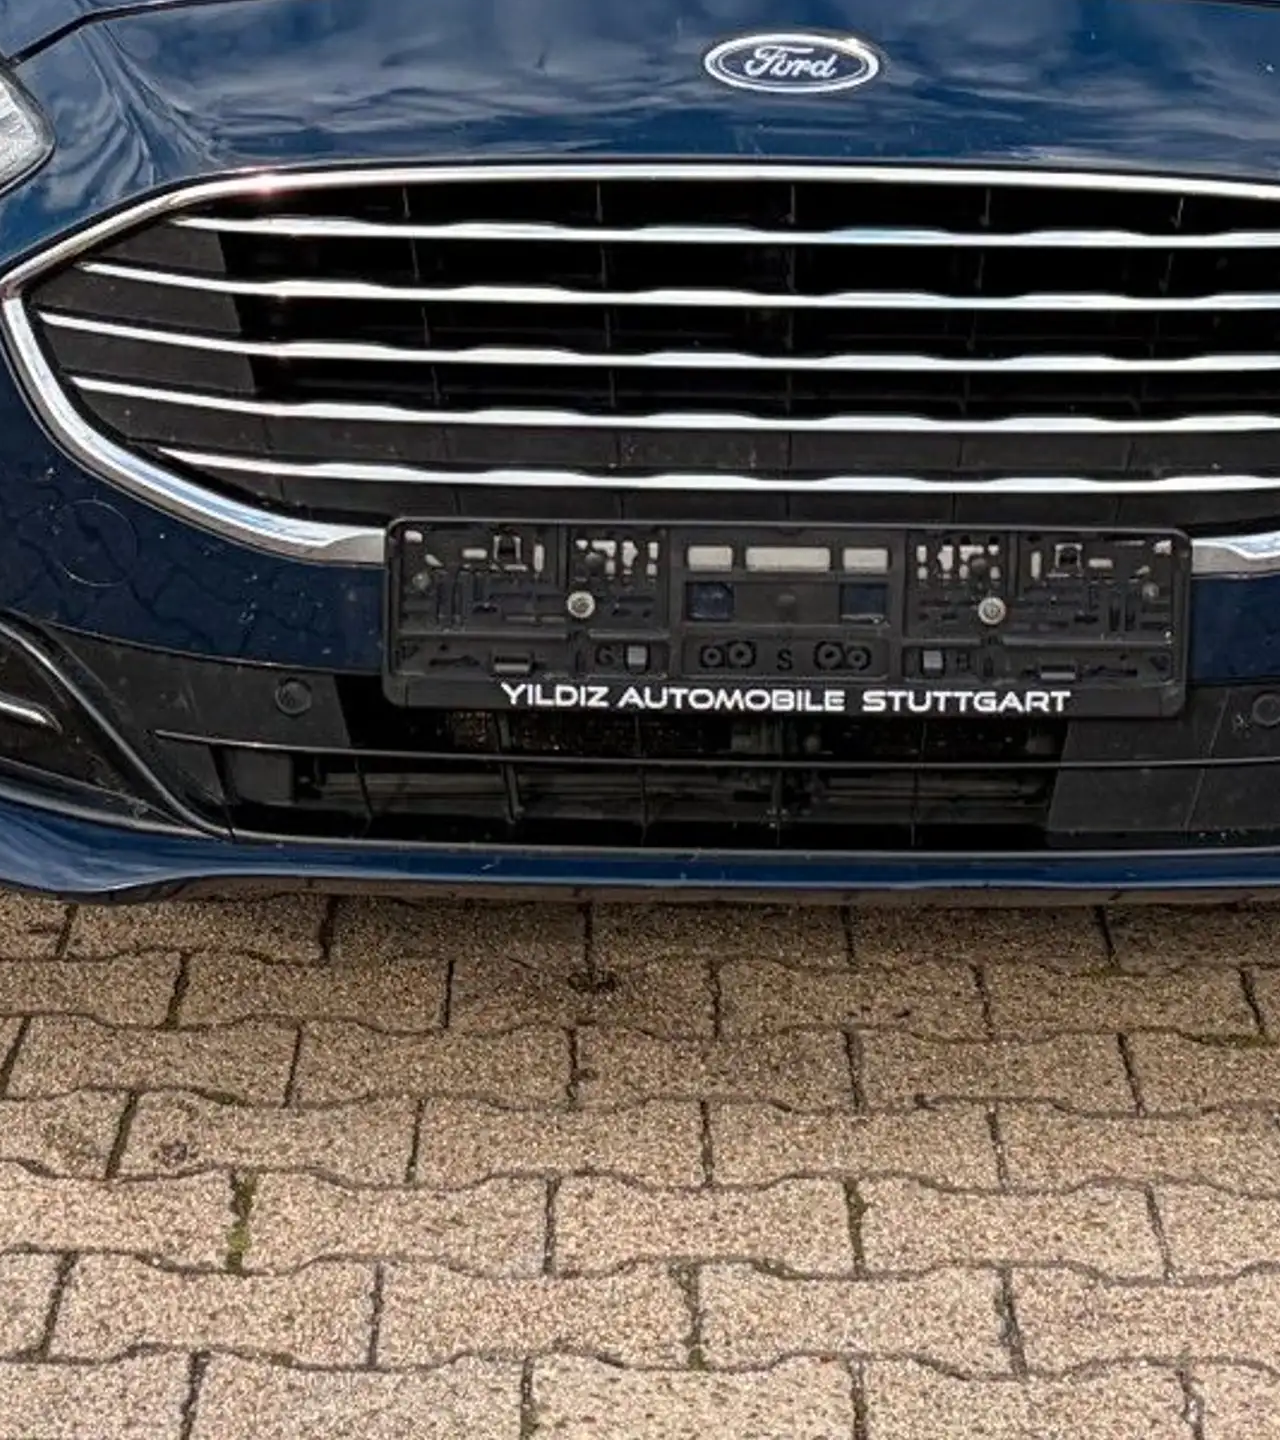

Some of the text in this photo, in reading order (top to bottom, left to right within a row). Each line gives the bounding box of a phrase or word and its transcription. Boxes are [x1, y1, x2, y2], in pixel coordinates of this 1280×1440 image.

[743, 44, 839, 78] Ford
[499, 682, 1072, 713] YILDIZ AUTOMOBILE STUTTGART
